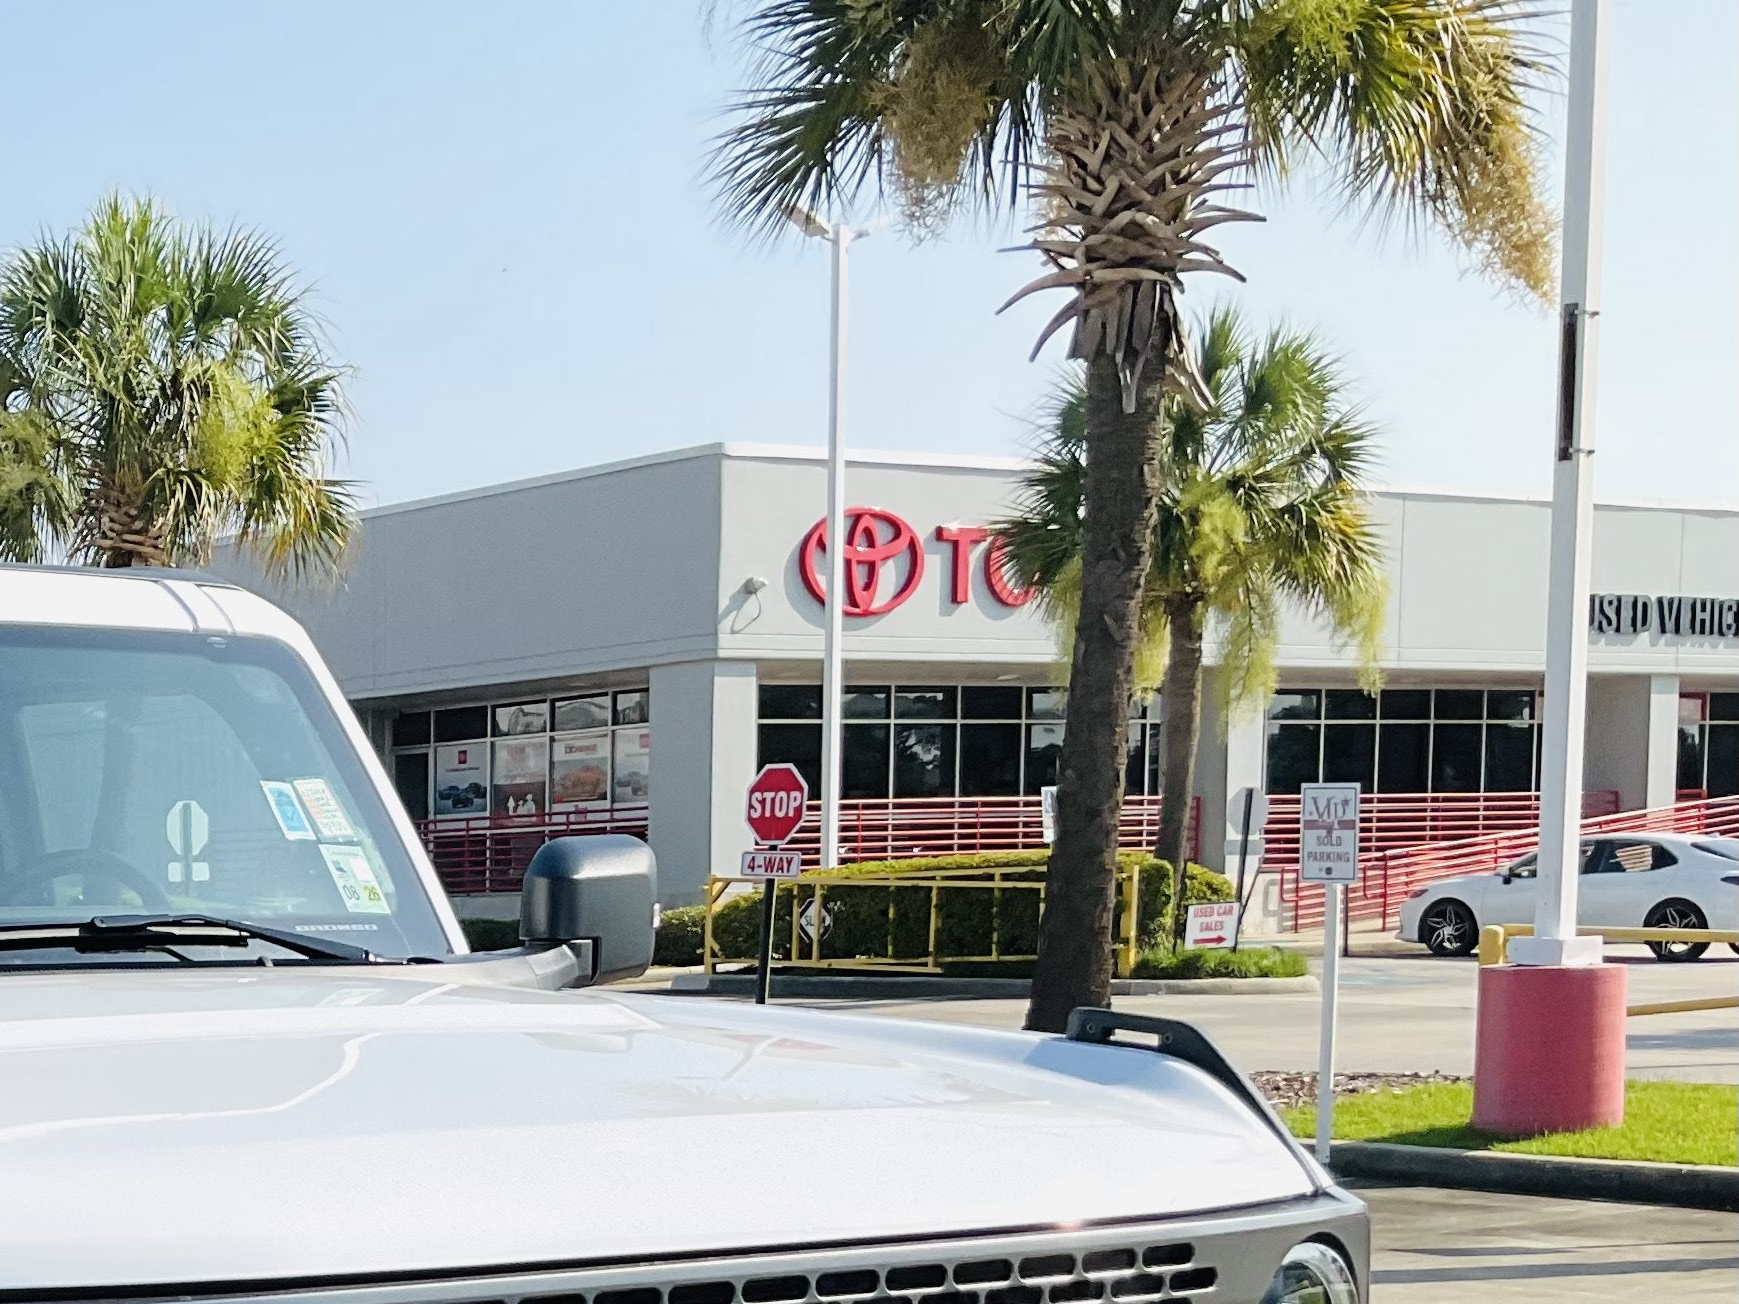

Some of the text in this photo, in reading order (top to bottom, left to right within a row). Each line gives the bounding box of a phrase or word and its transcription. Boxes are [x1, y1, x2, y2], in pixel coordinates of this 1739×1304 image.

[749, 790, 802, 819] STOP
[1316, 835, 1342, 847] SOLD
[1307, 851, 1350, 863] PARKING
[747, 855, 795, 874] 4-WAY
[342, 884, 381, 901] 08 26
[1193, 905, 1234, 918] USED CAR
[294, 923, 378, 932] BRONCO
[1199, 920, 1225, 932] SALES
